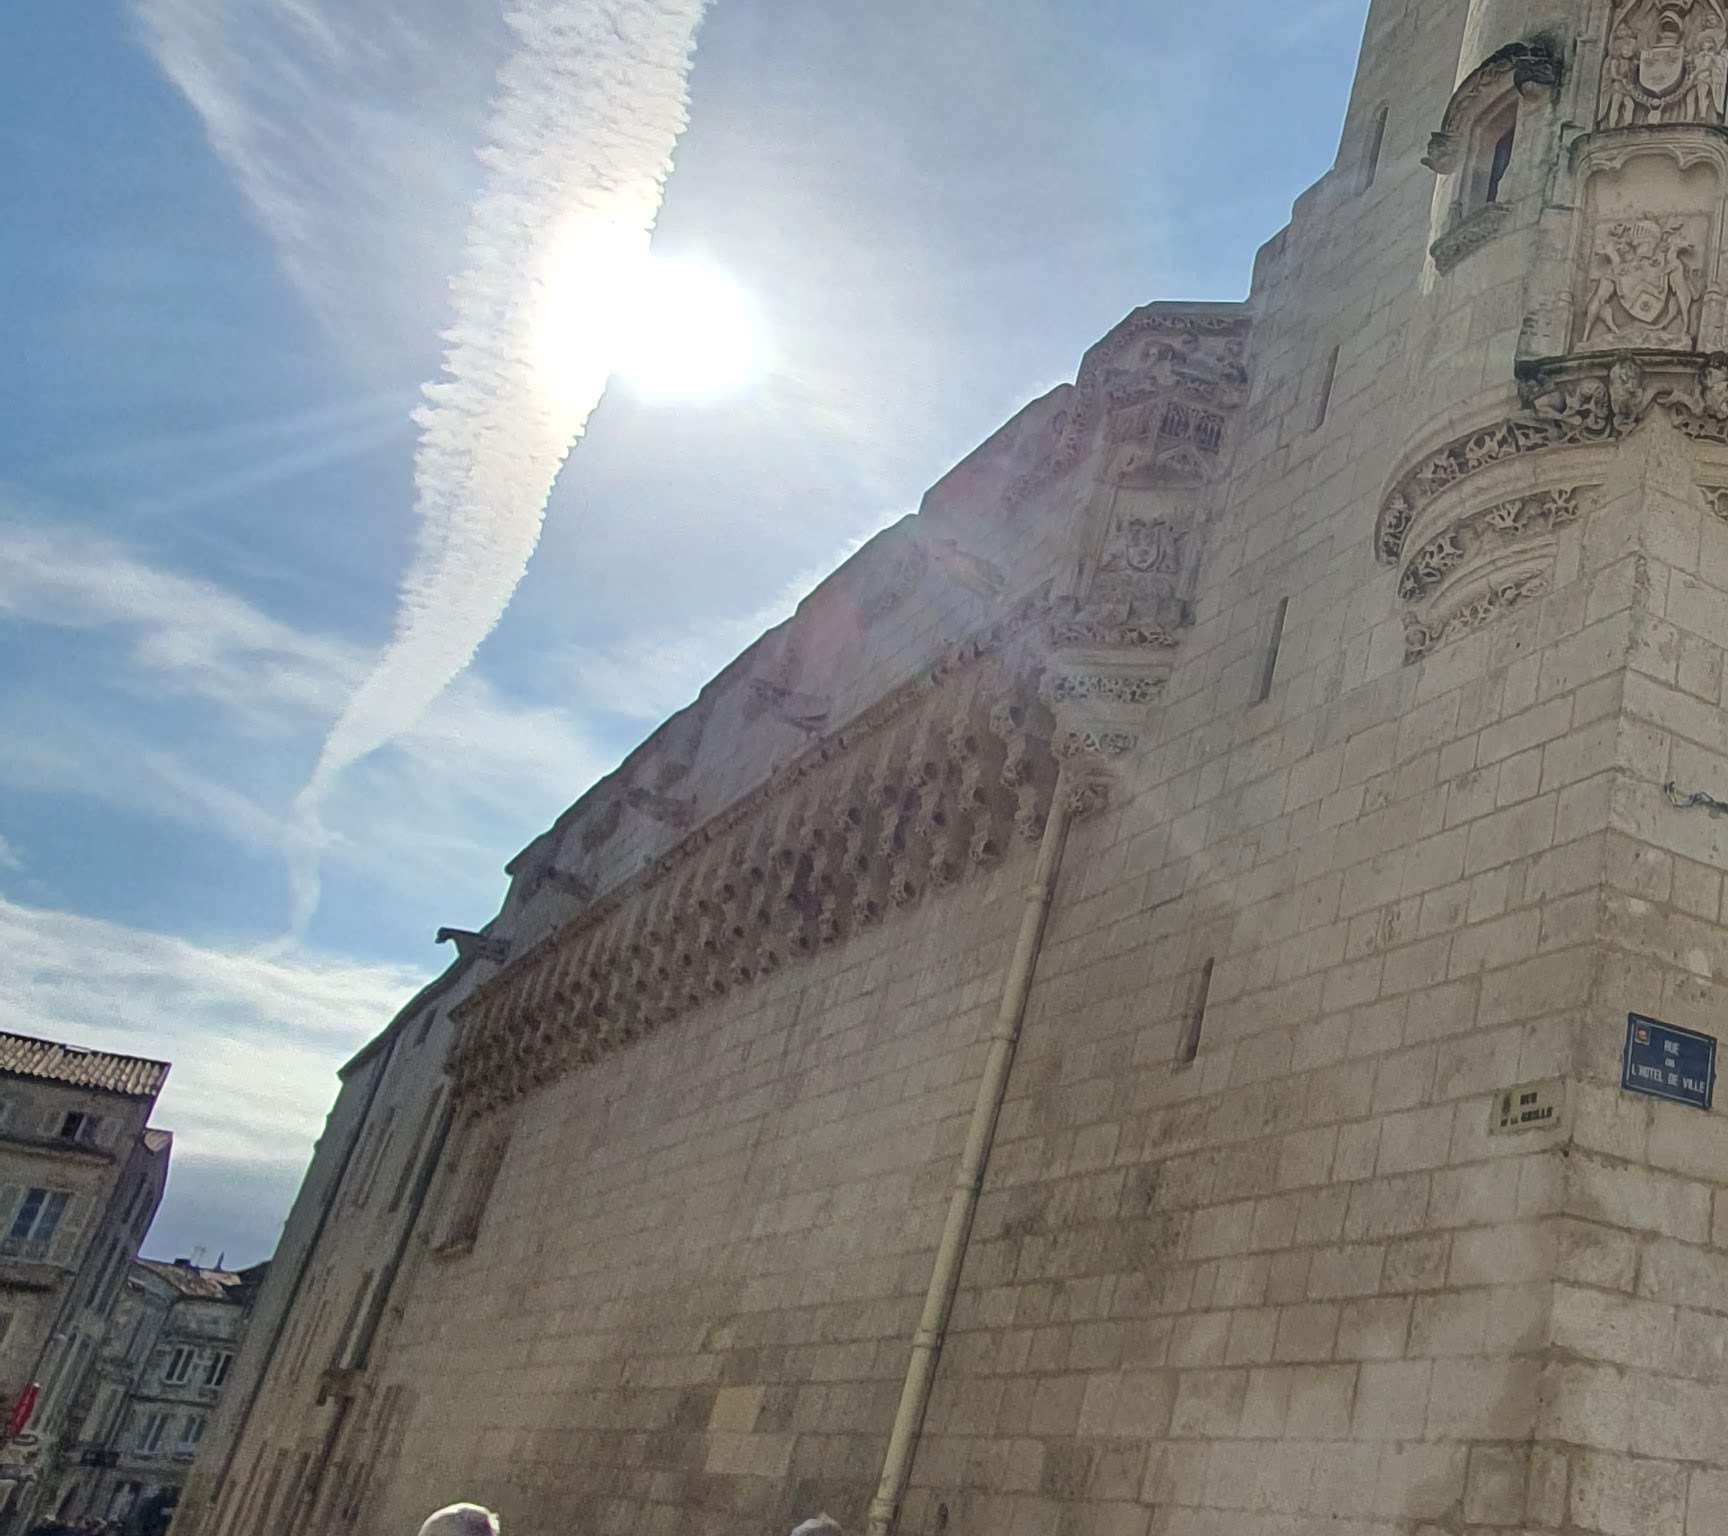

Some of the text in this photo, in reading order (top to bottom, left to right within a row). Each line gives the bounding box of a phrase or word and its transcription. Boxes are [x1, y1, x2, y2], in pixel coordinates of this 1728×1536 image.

[1664, 1039, 1680, 1056] RUE
[1667, 1072, 1678, 1087] DE
[1682, 1077, 1705, 1094] VILLE
